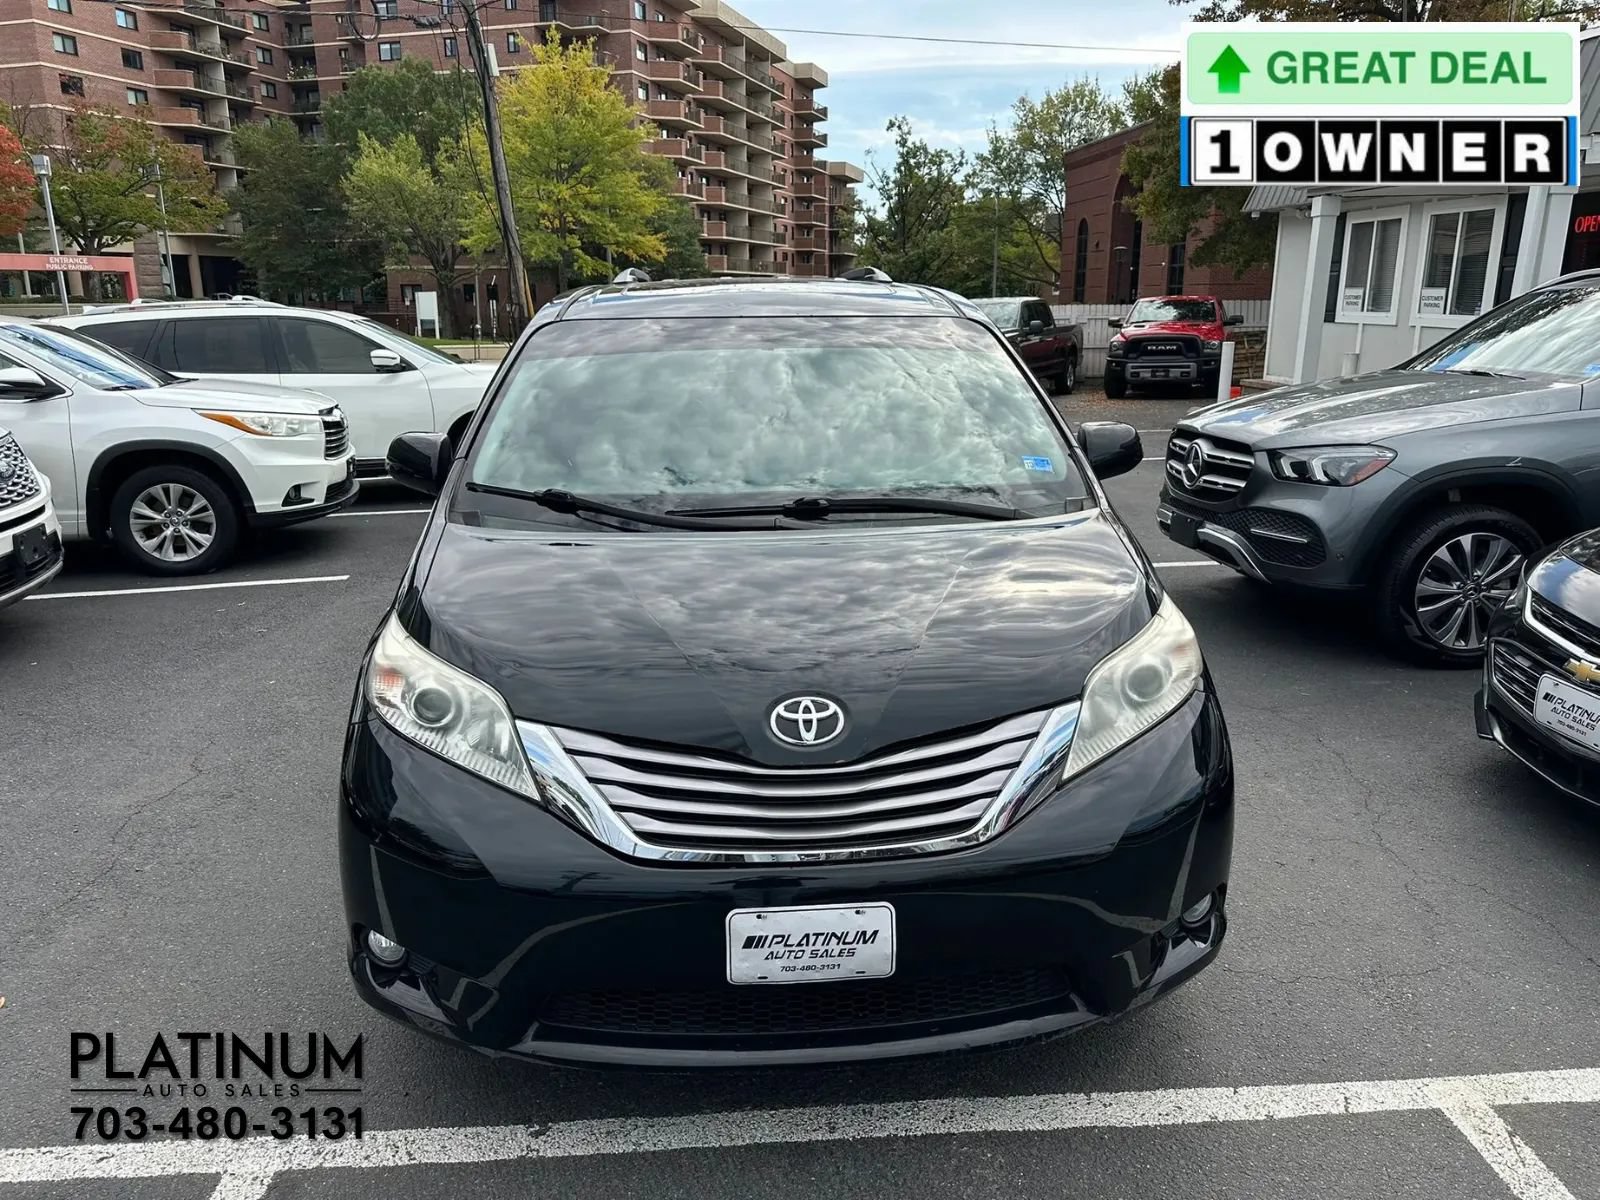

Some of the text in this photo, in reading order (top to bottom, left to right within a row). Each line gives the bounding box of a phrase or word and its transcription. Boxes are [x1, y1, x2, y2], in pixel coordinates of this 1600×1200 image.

[49, 256, 88, 265] ENTRANCE
[1550, 706, 1596, 731] AUTO SALES
[767, 929, 880, 948] PLATINUM
[764, 947, 857, 960] AUTO SALES
[780, 963, 841, 972] 703-480-3131
